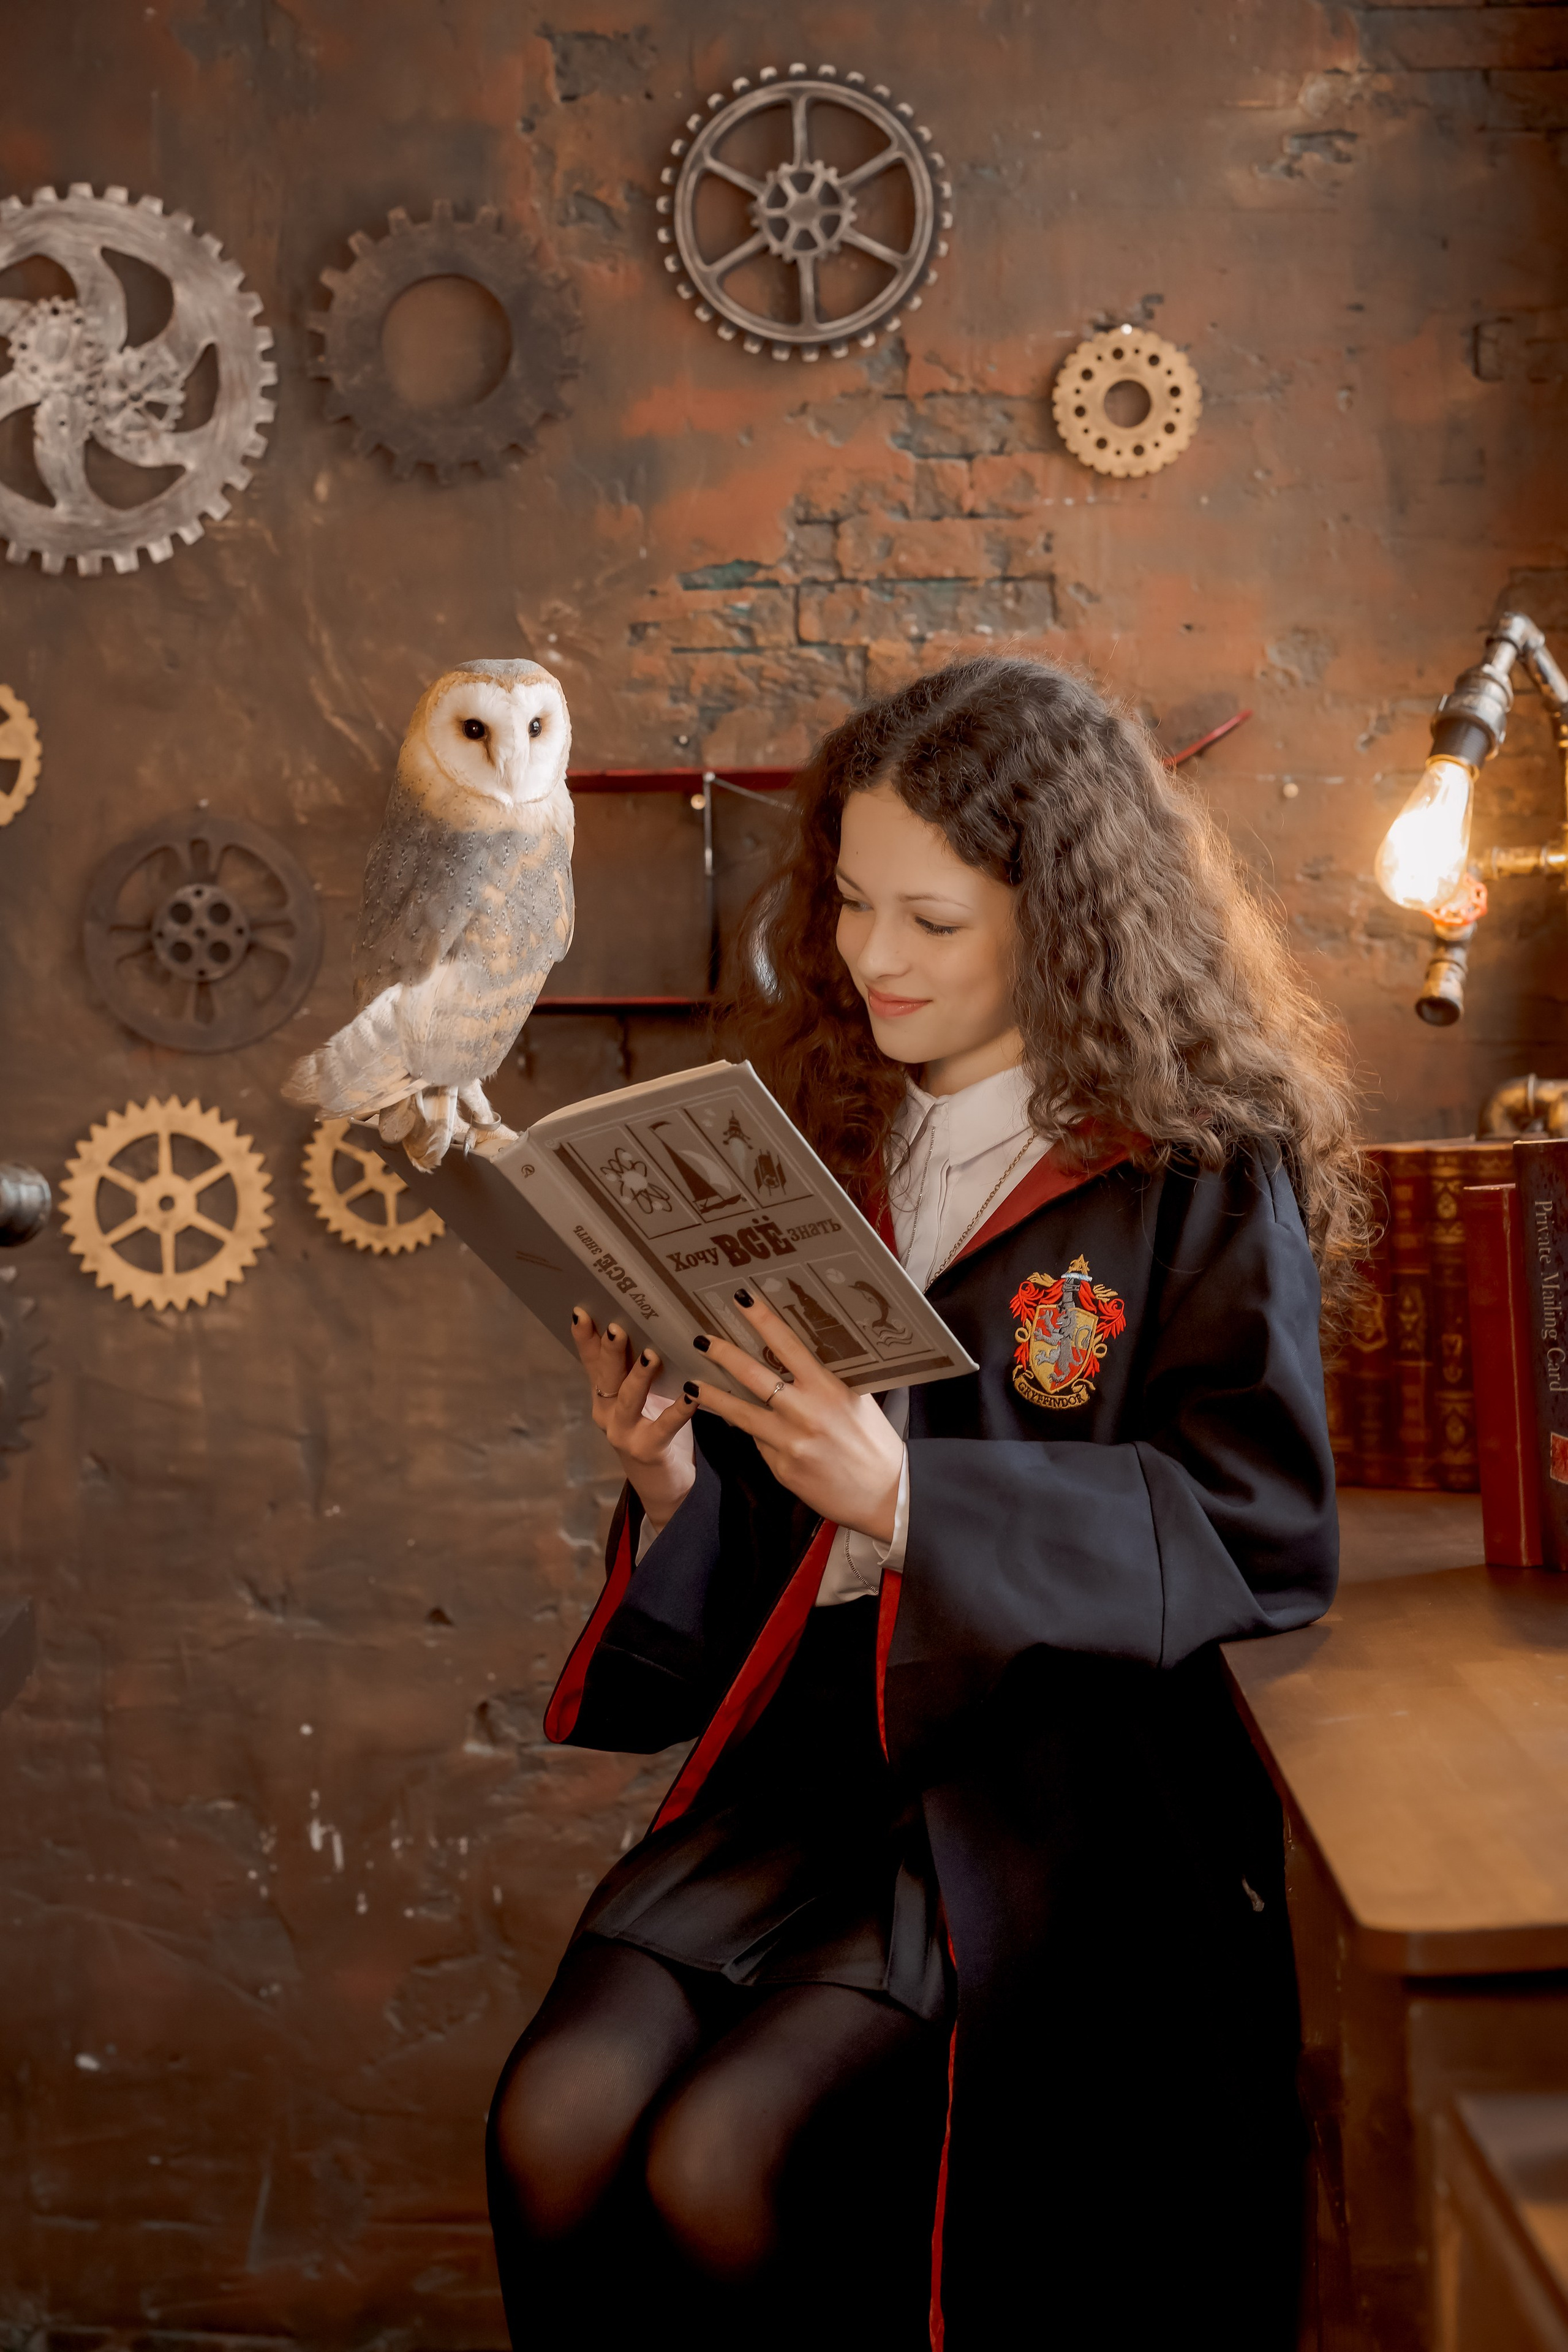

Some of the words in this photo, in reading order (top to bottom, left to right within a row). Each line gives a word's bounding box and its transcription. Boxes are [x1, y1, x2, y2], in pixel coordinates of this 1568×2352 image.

[573, 1224, 603, 1256] знать
[665, 1246, 720, 1273] Хочу
[709, 1215, 797, 1268] ВСЁ
[785, 1218, 843, 1242] знать
[1534, 1200, 1555, 1265] Private
[592, 1253, 638, 1294] ВСЁ
[628, 1292, 660, 1321] Хочу
[1540, 1272, 1563, 1341] Mailing
[1547, 1347, 1568, 1392] Card
[1017, 1382, 1085, 1408] GRYFFINDOR
